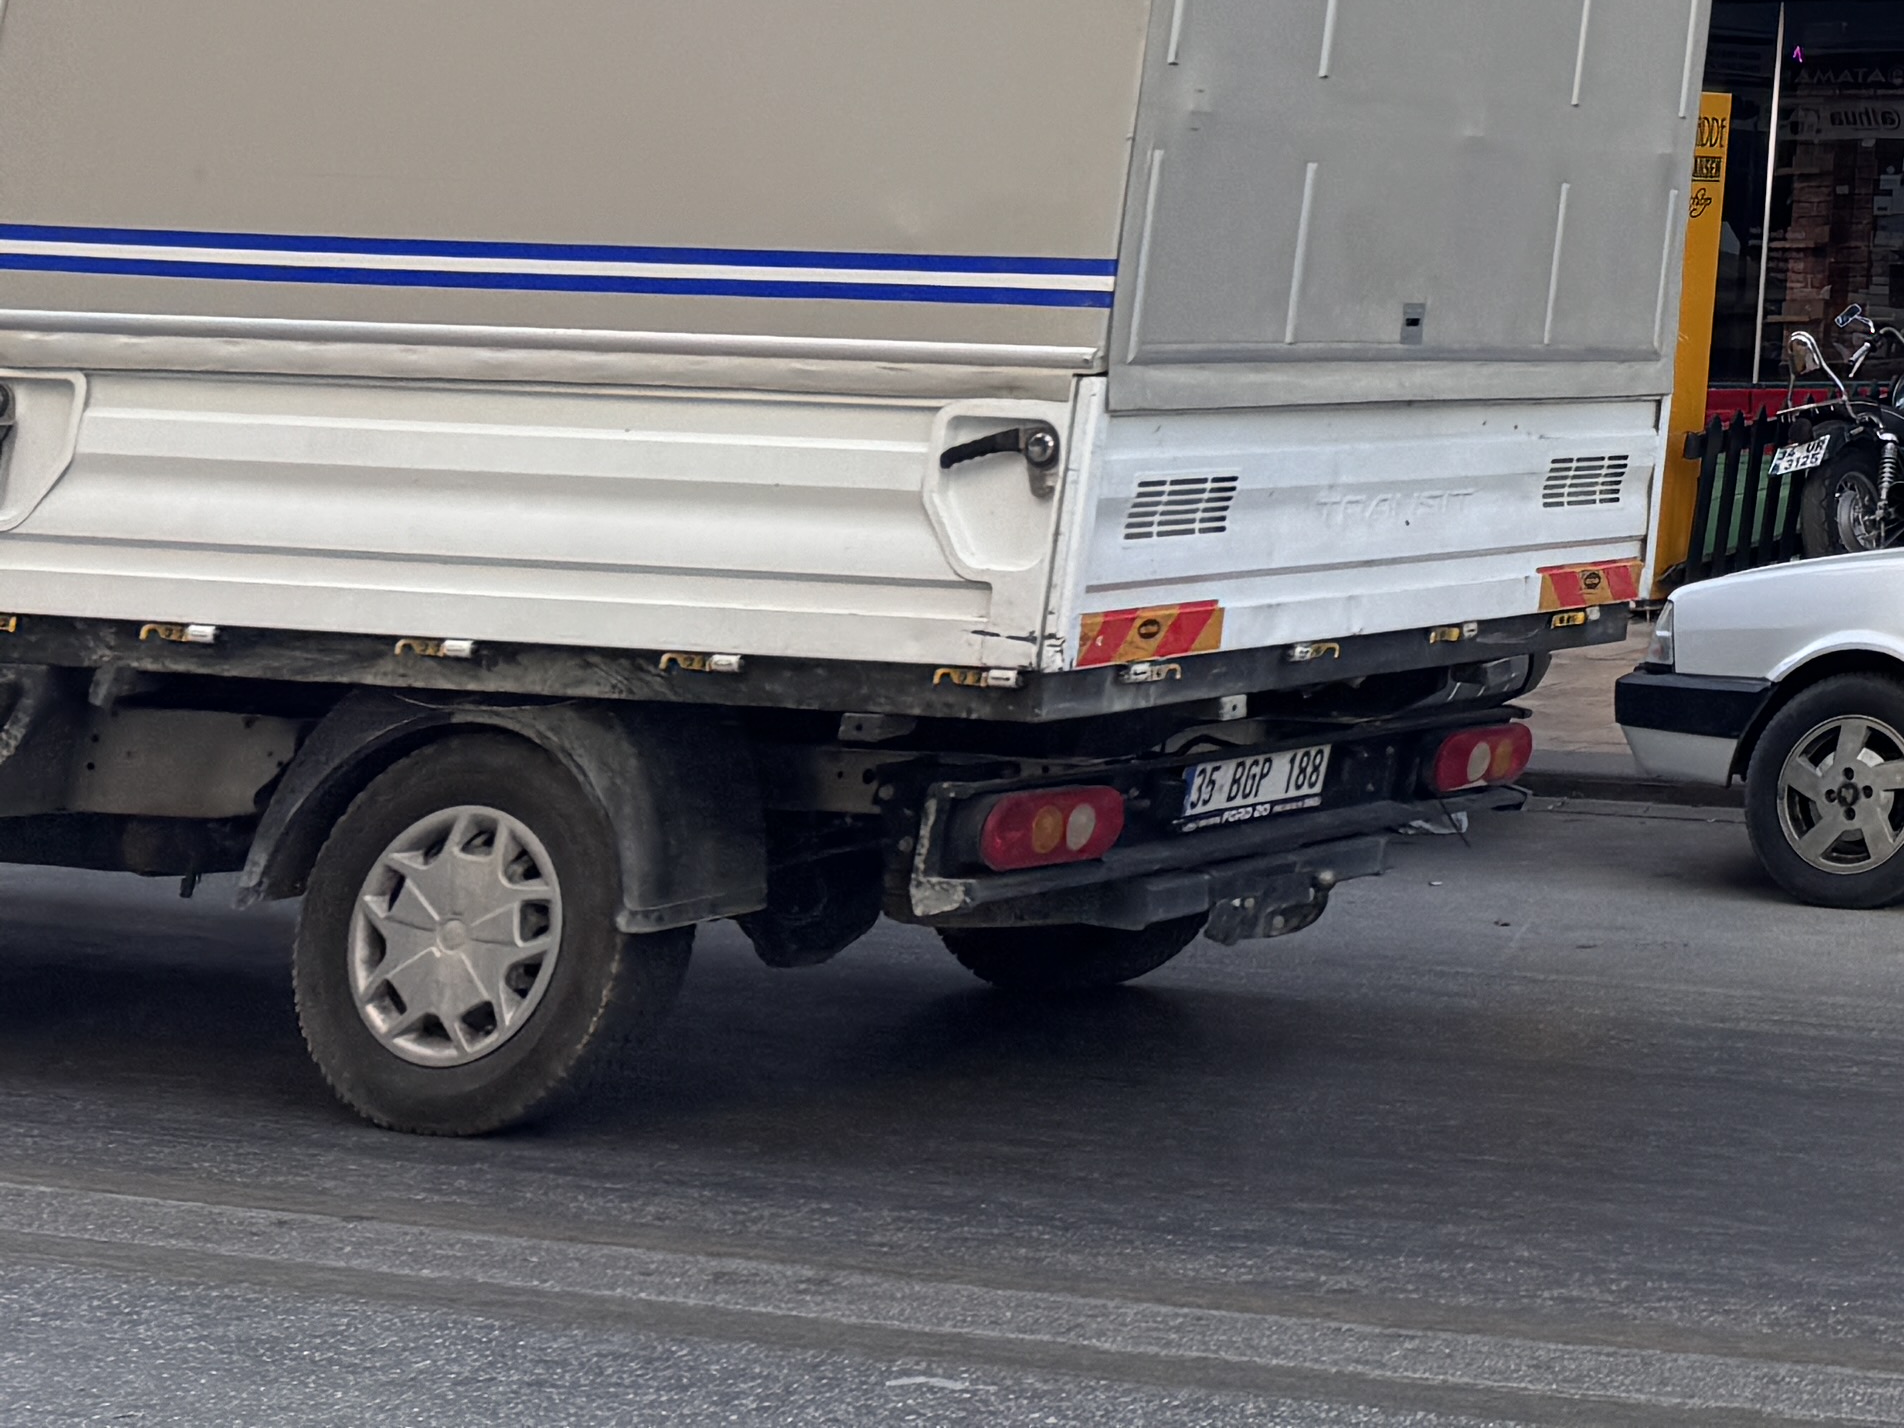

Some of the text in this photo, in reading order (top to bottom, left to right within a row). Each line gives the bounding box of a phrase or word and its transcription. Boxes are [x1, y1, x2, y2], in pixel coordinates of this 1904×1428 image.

[1190, 765, 1222, 810] 35
[1226, 756, 1273, 803] BGP
[1285, 748, 1325, 794] 188
